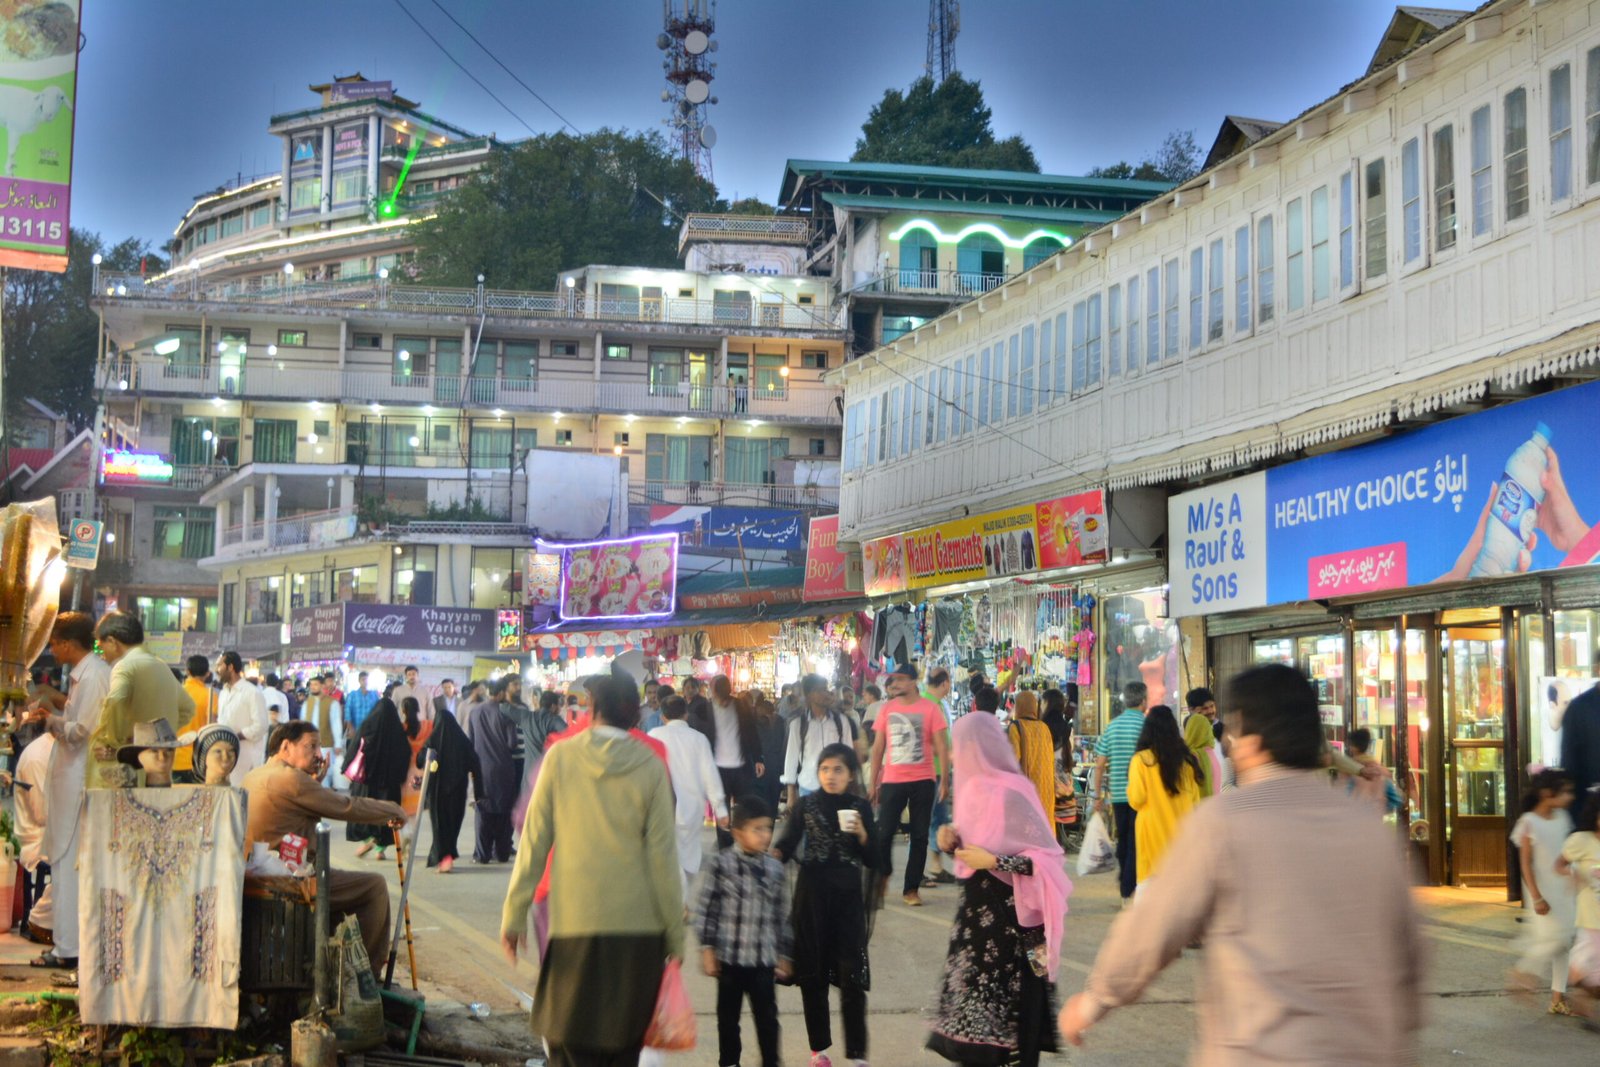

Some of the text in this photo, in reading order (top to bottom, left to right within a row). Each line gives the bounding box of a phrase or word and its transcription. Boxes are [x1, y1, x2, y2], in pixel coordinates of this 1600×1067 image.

[1274, 485, 1351, 529] HEALTHY
[1354, 467, 1429, 512] CHOICE
[1432, 453, 1468, 513] اپناؤ
[1187, 492, 1242, 535] M/s A
[905, 529, 984, 578] Wahid Garments
[1185, 528, 1245, 570] Rauf &
[807, 558, 834, 583] Boy
[1191, 572, 1238, 604] Sons
[691, 595, 707, 609] Pay
[722, 592, 741, 604] Pick
[771, 590, 789, 602] Toys
[314, 608, 340, 620] Khayyam
[351, 612, 408, 636] Coca-Cola
[421, 608, 482, 625] Khayyam
[316, 619, 338, 632] Variety
[426, 621, 476, 636] Variety
[317, 632, 334, 643] Store
[430, 634, 467, 646] Store
